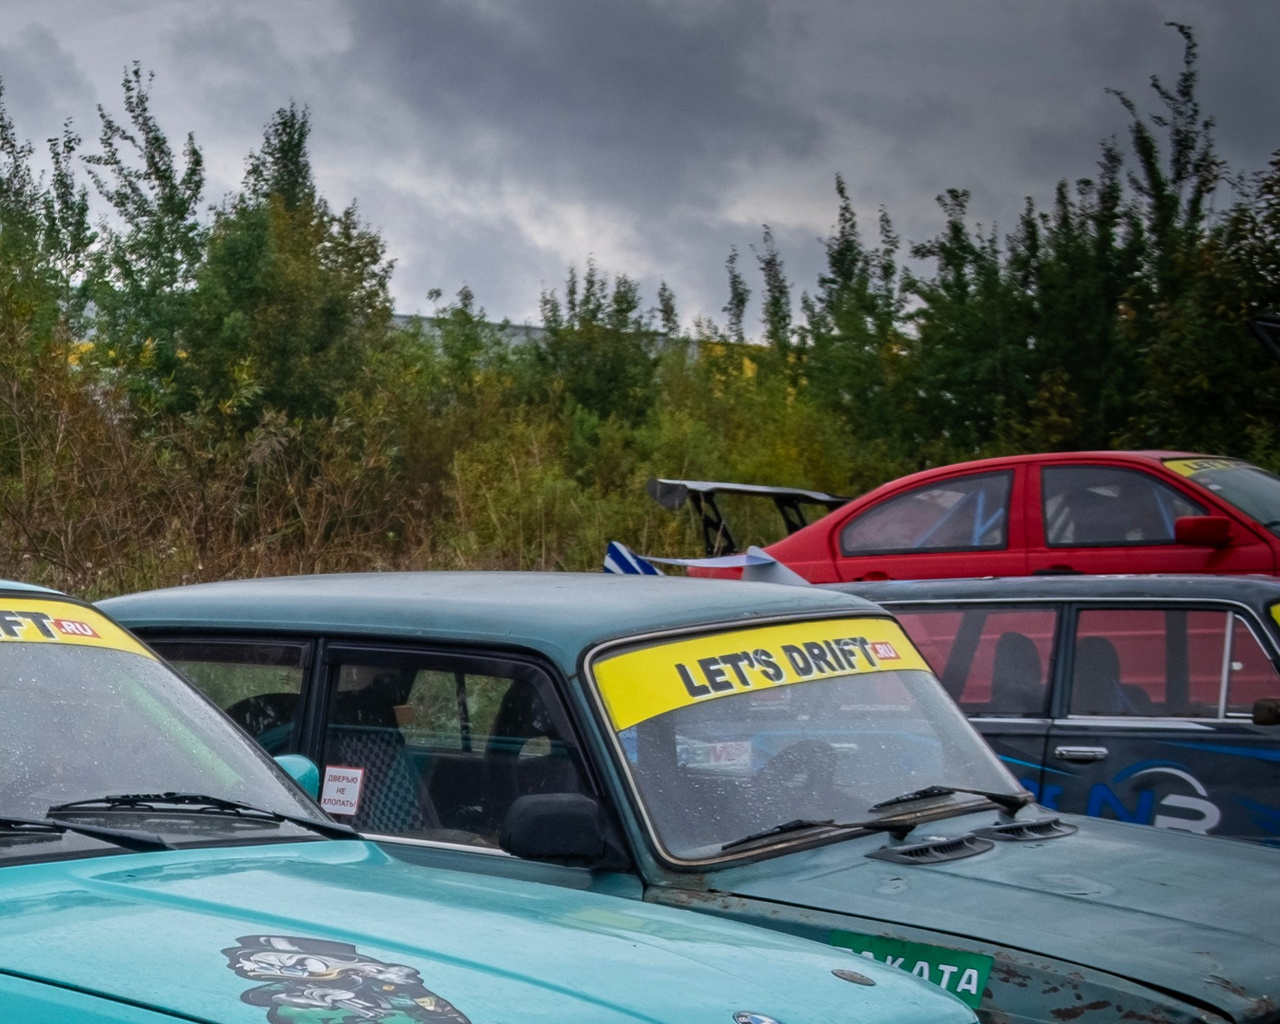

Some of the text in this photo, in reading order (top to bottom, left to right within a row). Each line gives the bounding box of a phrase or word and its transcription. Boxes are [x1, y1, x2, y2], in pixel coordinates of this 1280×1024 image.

[675, 648, 785, 698] LET'S
[327, 774, 358, 784] ДВЕРЬЮ
[336, 786, 347, 795] НЕ
